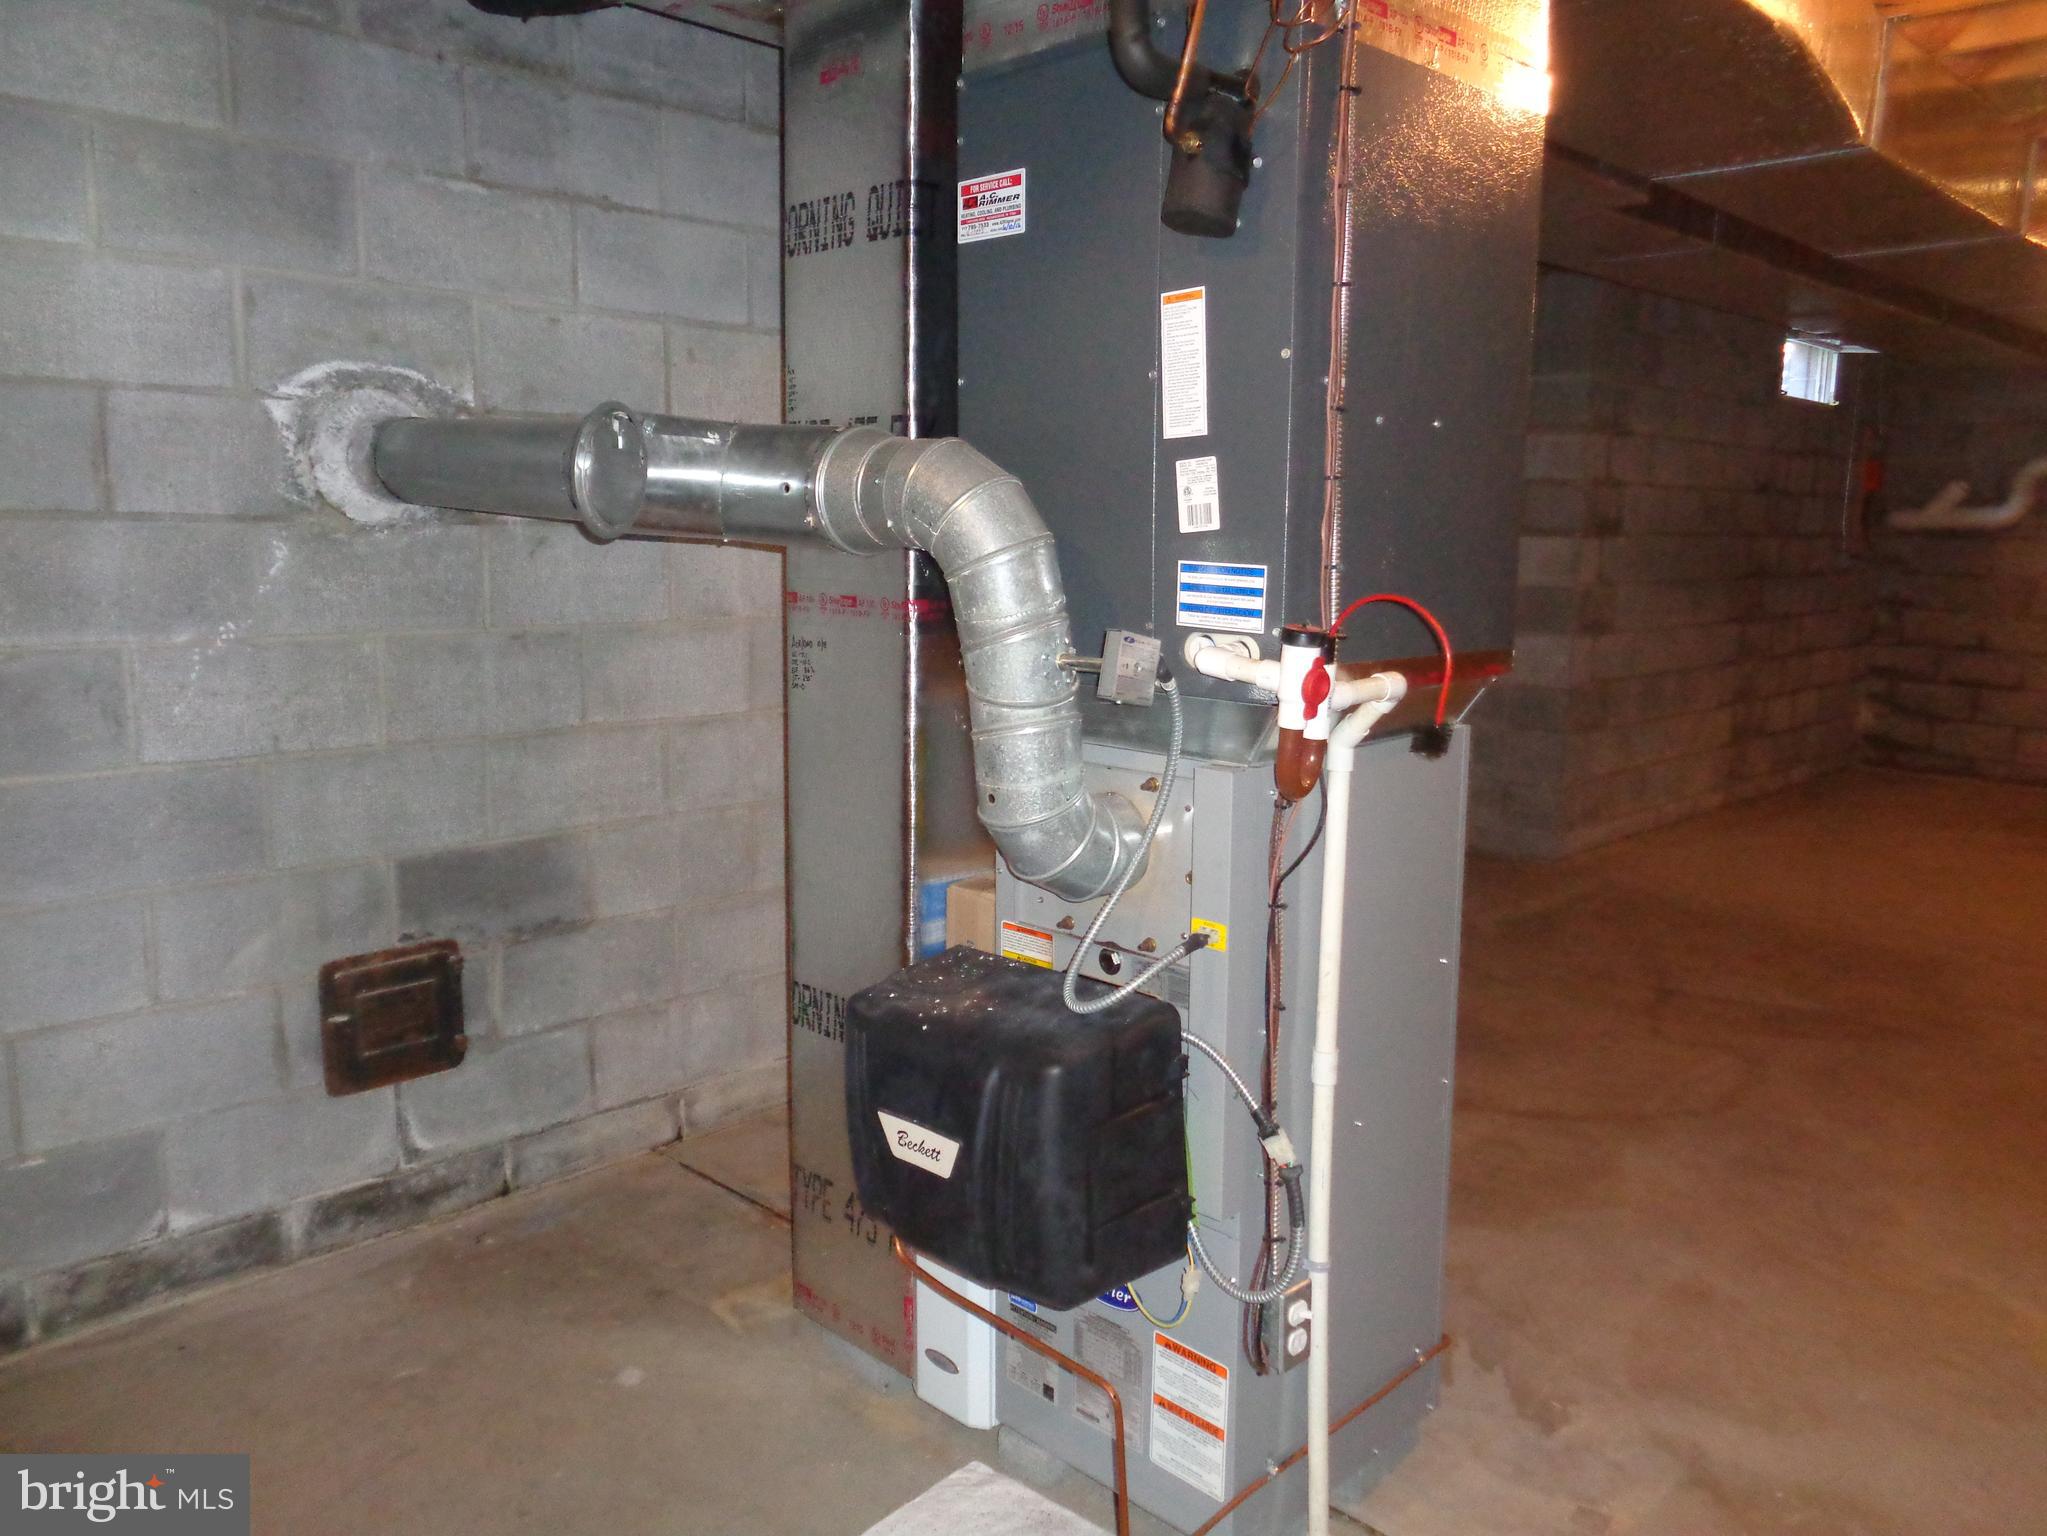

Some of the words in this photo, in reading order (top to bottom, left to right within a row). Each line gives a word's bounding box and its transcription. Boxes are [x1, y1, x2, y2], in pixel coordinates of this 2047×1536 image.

[970, 185, 979, 194] FOR
[980, 180, 999, 192] SERVICE
[978, 193, 1021, 207] RIMMER
[786, 191, 856, 257] ORNING
[792, 981, 847, 1043] ORNIN
[896, 1130, 942, 1162] Beckett
[1171, 1341, 1218, 1375] WARNING
